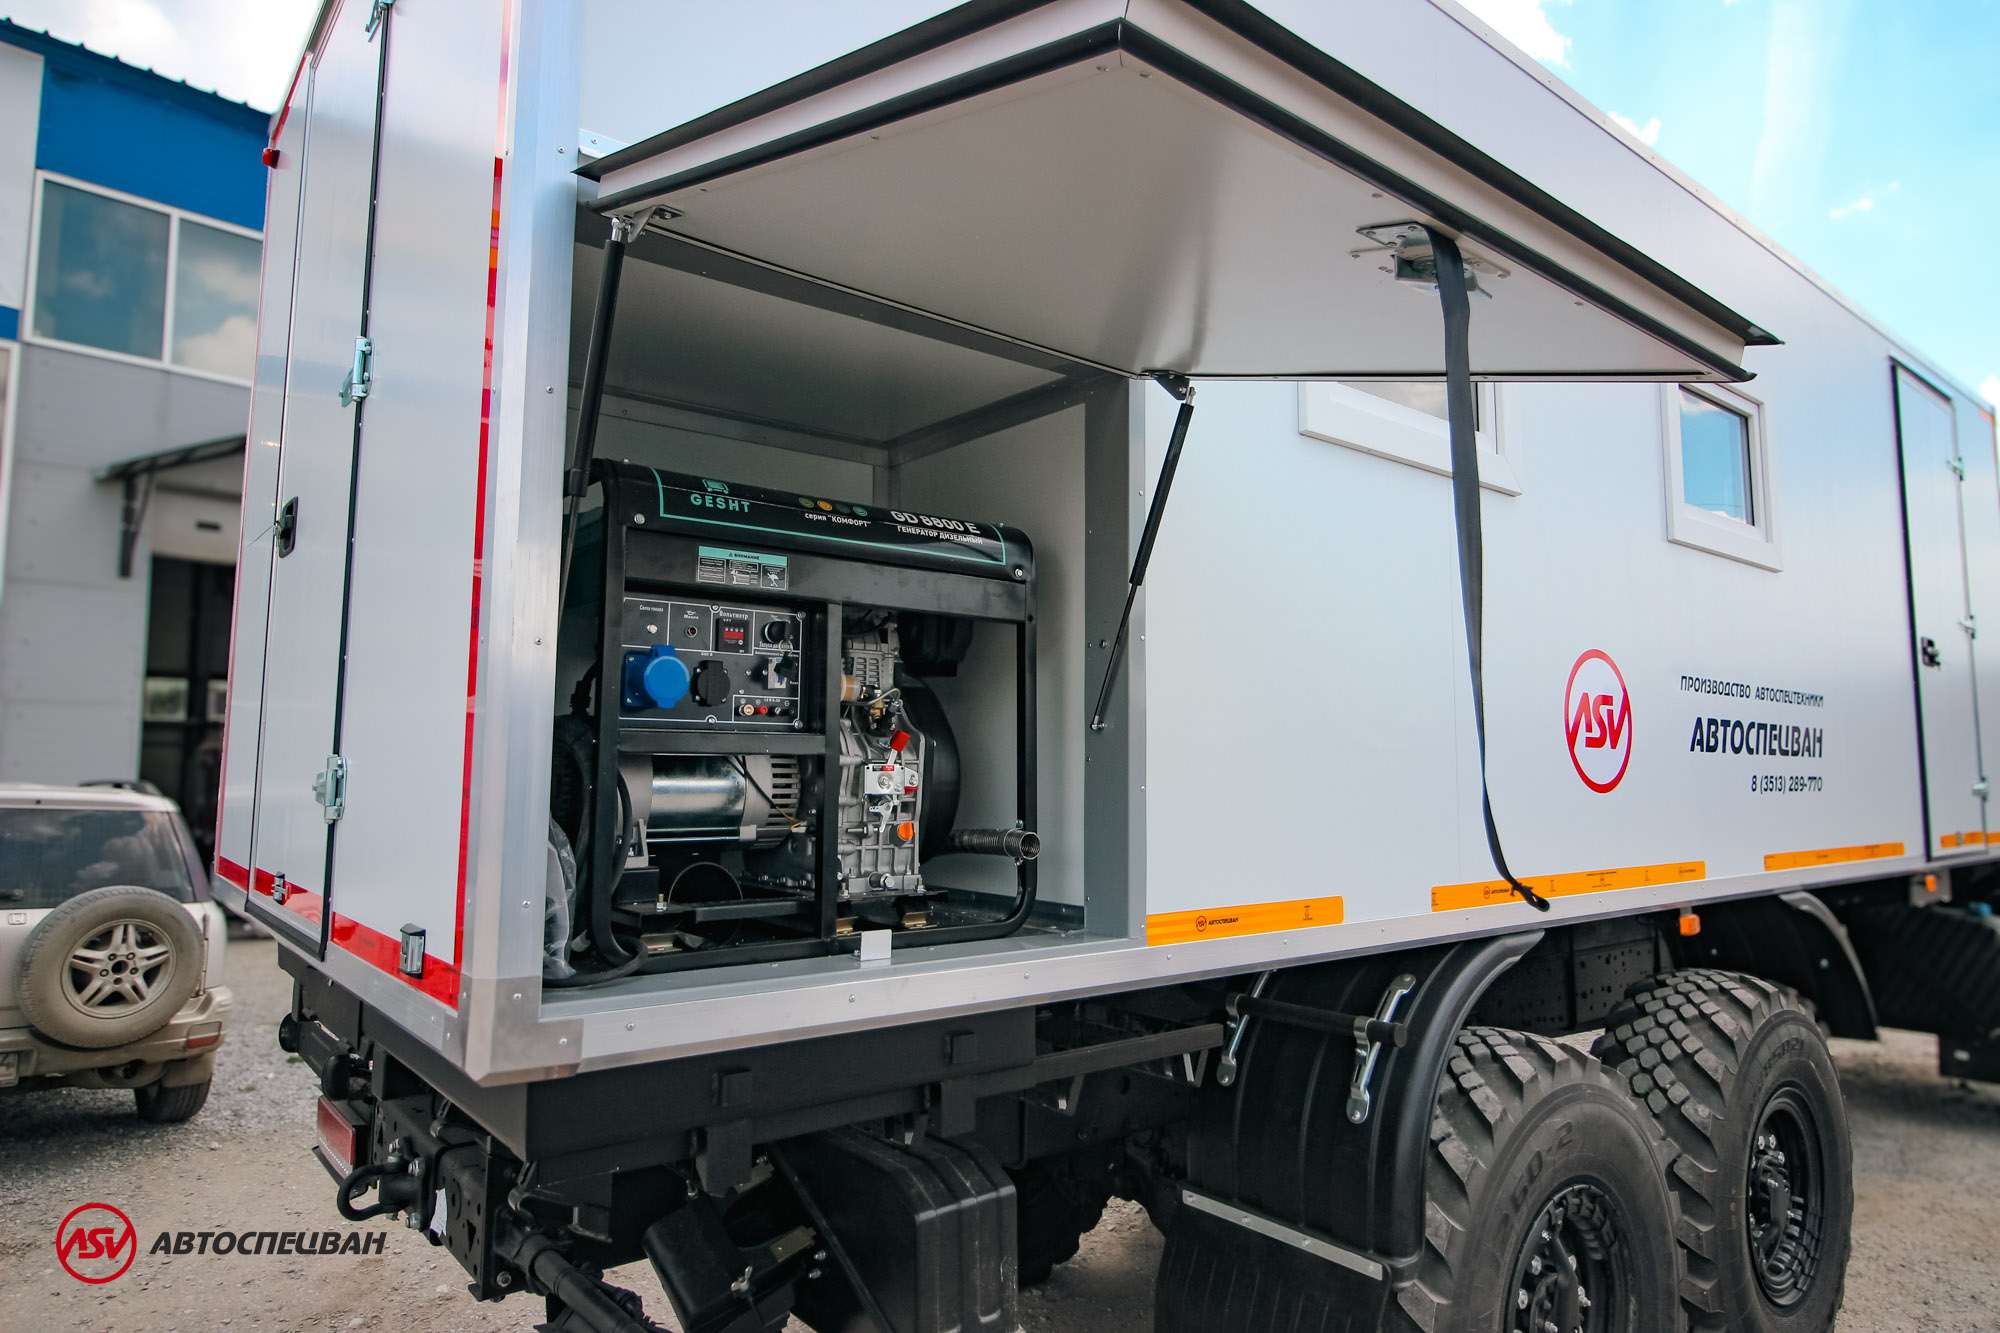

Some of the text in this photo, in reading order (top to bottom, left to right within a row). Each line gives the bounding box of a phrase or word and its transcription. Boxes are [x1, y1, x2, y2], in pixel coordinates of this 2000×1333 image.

[690, 493, 750, 513] GESHT
[804, 512, 827, 521] серия
[890, 510, 981, 534] GD 8800 E
[897, 525, 983, 544] ГЕНЕРАТОР ДИЗЕЛЬНЫЙ
[1680, 675, 1824, 707] ПРОИЗВОДСТВО АВТОСПЕЦТЕХНИКИ
[1568, 690, 1630, 751] ASV
[1690, 716, 1823, 758] АВТОСПЕЦВАН
[1751, 775, 1823, 794] 8 (3513) 289-770
